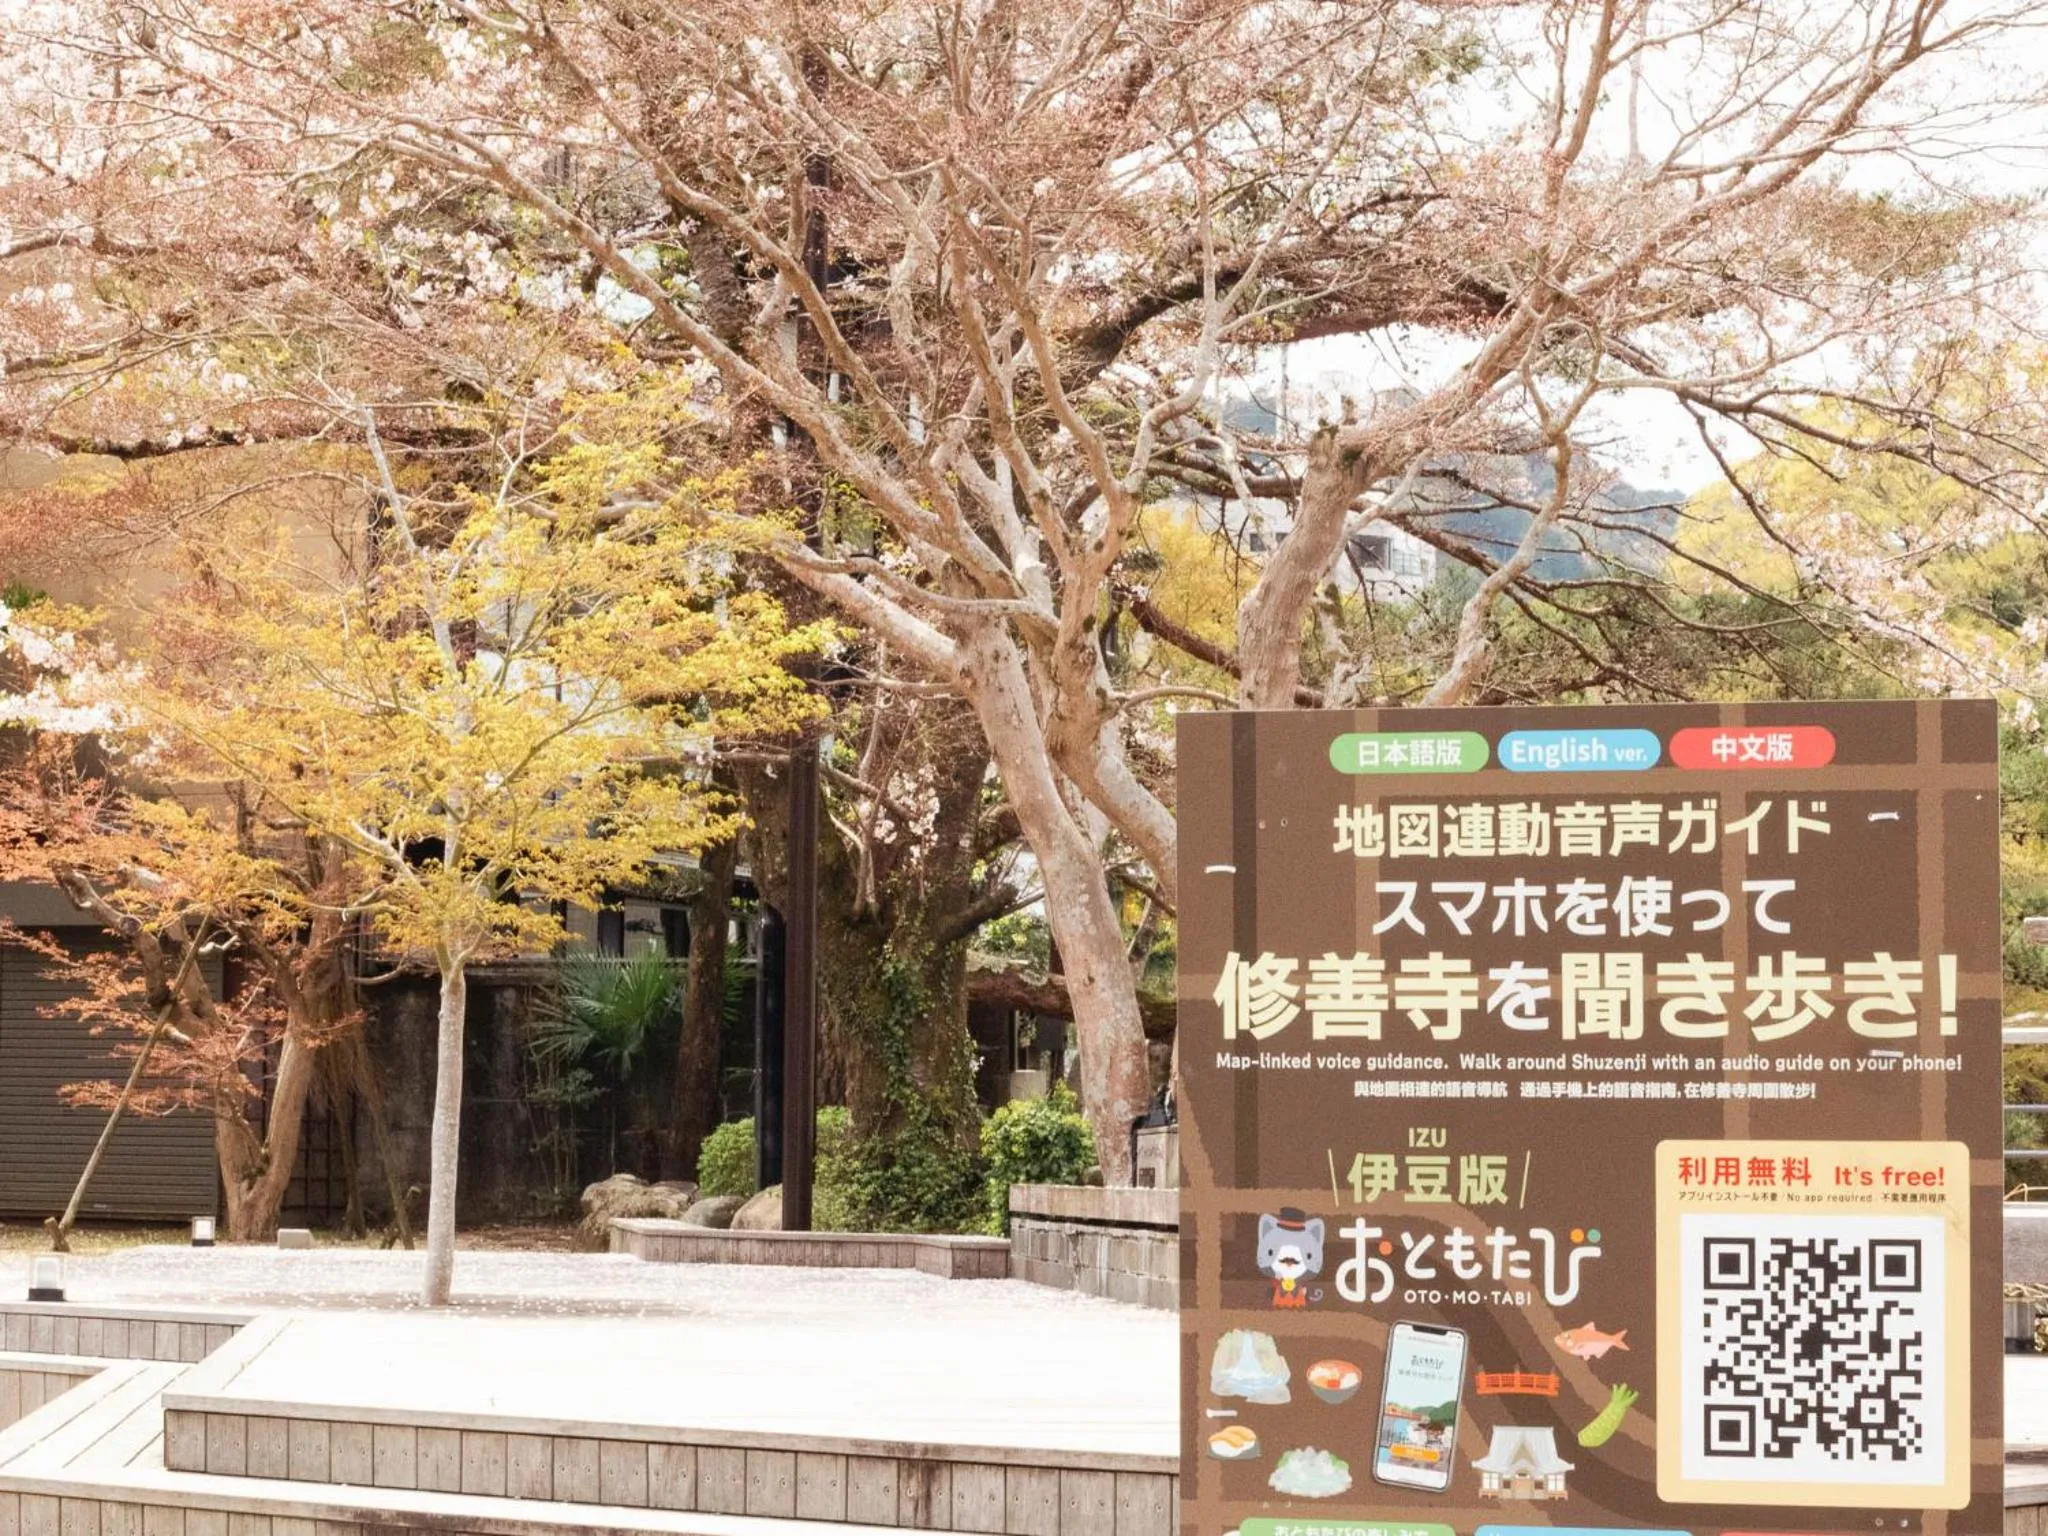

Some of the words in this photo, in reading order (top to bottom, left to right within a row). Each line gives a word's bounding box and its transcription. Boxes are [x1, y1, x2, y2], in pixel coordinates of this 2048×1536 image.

[1358, 738, 1462, 767] 日本語版
[1511, 738, 1609, 769] English
[1614, 747, 1649, 762] ver.
[1711, 733, 1793, 762] 中文版
[1332, 799, 1831, 858] 地図連動音声ガイド
[1372, 876, 1796, 937] スマホを使って
[1212, 951, 1958, 1042] 修善寺を聞き歩き!
[1216, 1052, 1312, 1070] Map-linked
[1316, 1053, 1362, 1070] voice
[1366, 1053, 1449, 1072] guidance.
[1460, 1053, 1502, 1070] Walk
[1506, 1053, 1567, 1071] around
[1571, 1053, 1647, 1072] Shuzenji
[1651, 1053, 1689, 1071] with
[1694, 1056, 1716, 1071] an
[1721, 1053, 1770, 1071] audio
[1775, 1053, 1824, 1072] guide
[1829, 1056, 1851, 1071] on
[1856, 1057, 1898, 1072] your
[1902, 1054, 1963, 1072] phone!
[1408, 1127, 1447, 1148] IZU
[1347, 1152, 1509, 1205] 伊豆版
[1678, 1156, 1812, 1187] 利用無料
[1835, 1166, 1873, 1187] It's
[1881, 1166, 1945, 1187] free!
[1786, 1192, 1801, 1203] No
[1804, 1193, 1823, 1204] app
[1827, 1192, 1874, 1204] required
[1335, 1217, 1602, 1306] おともたび
